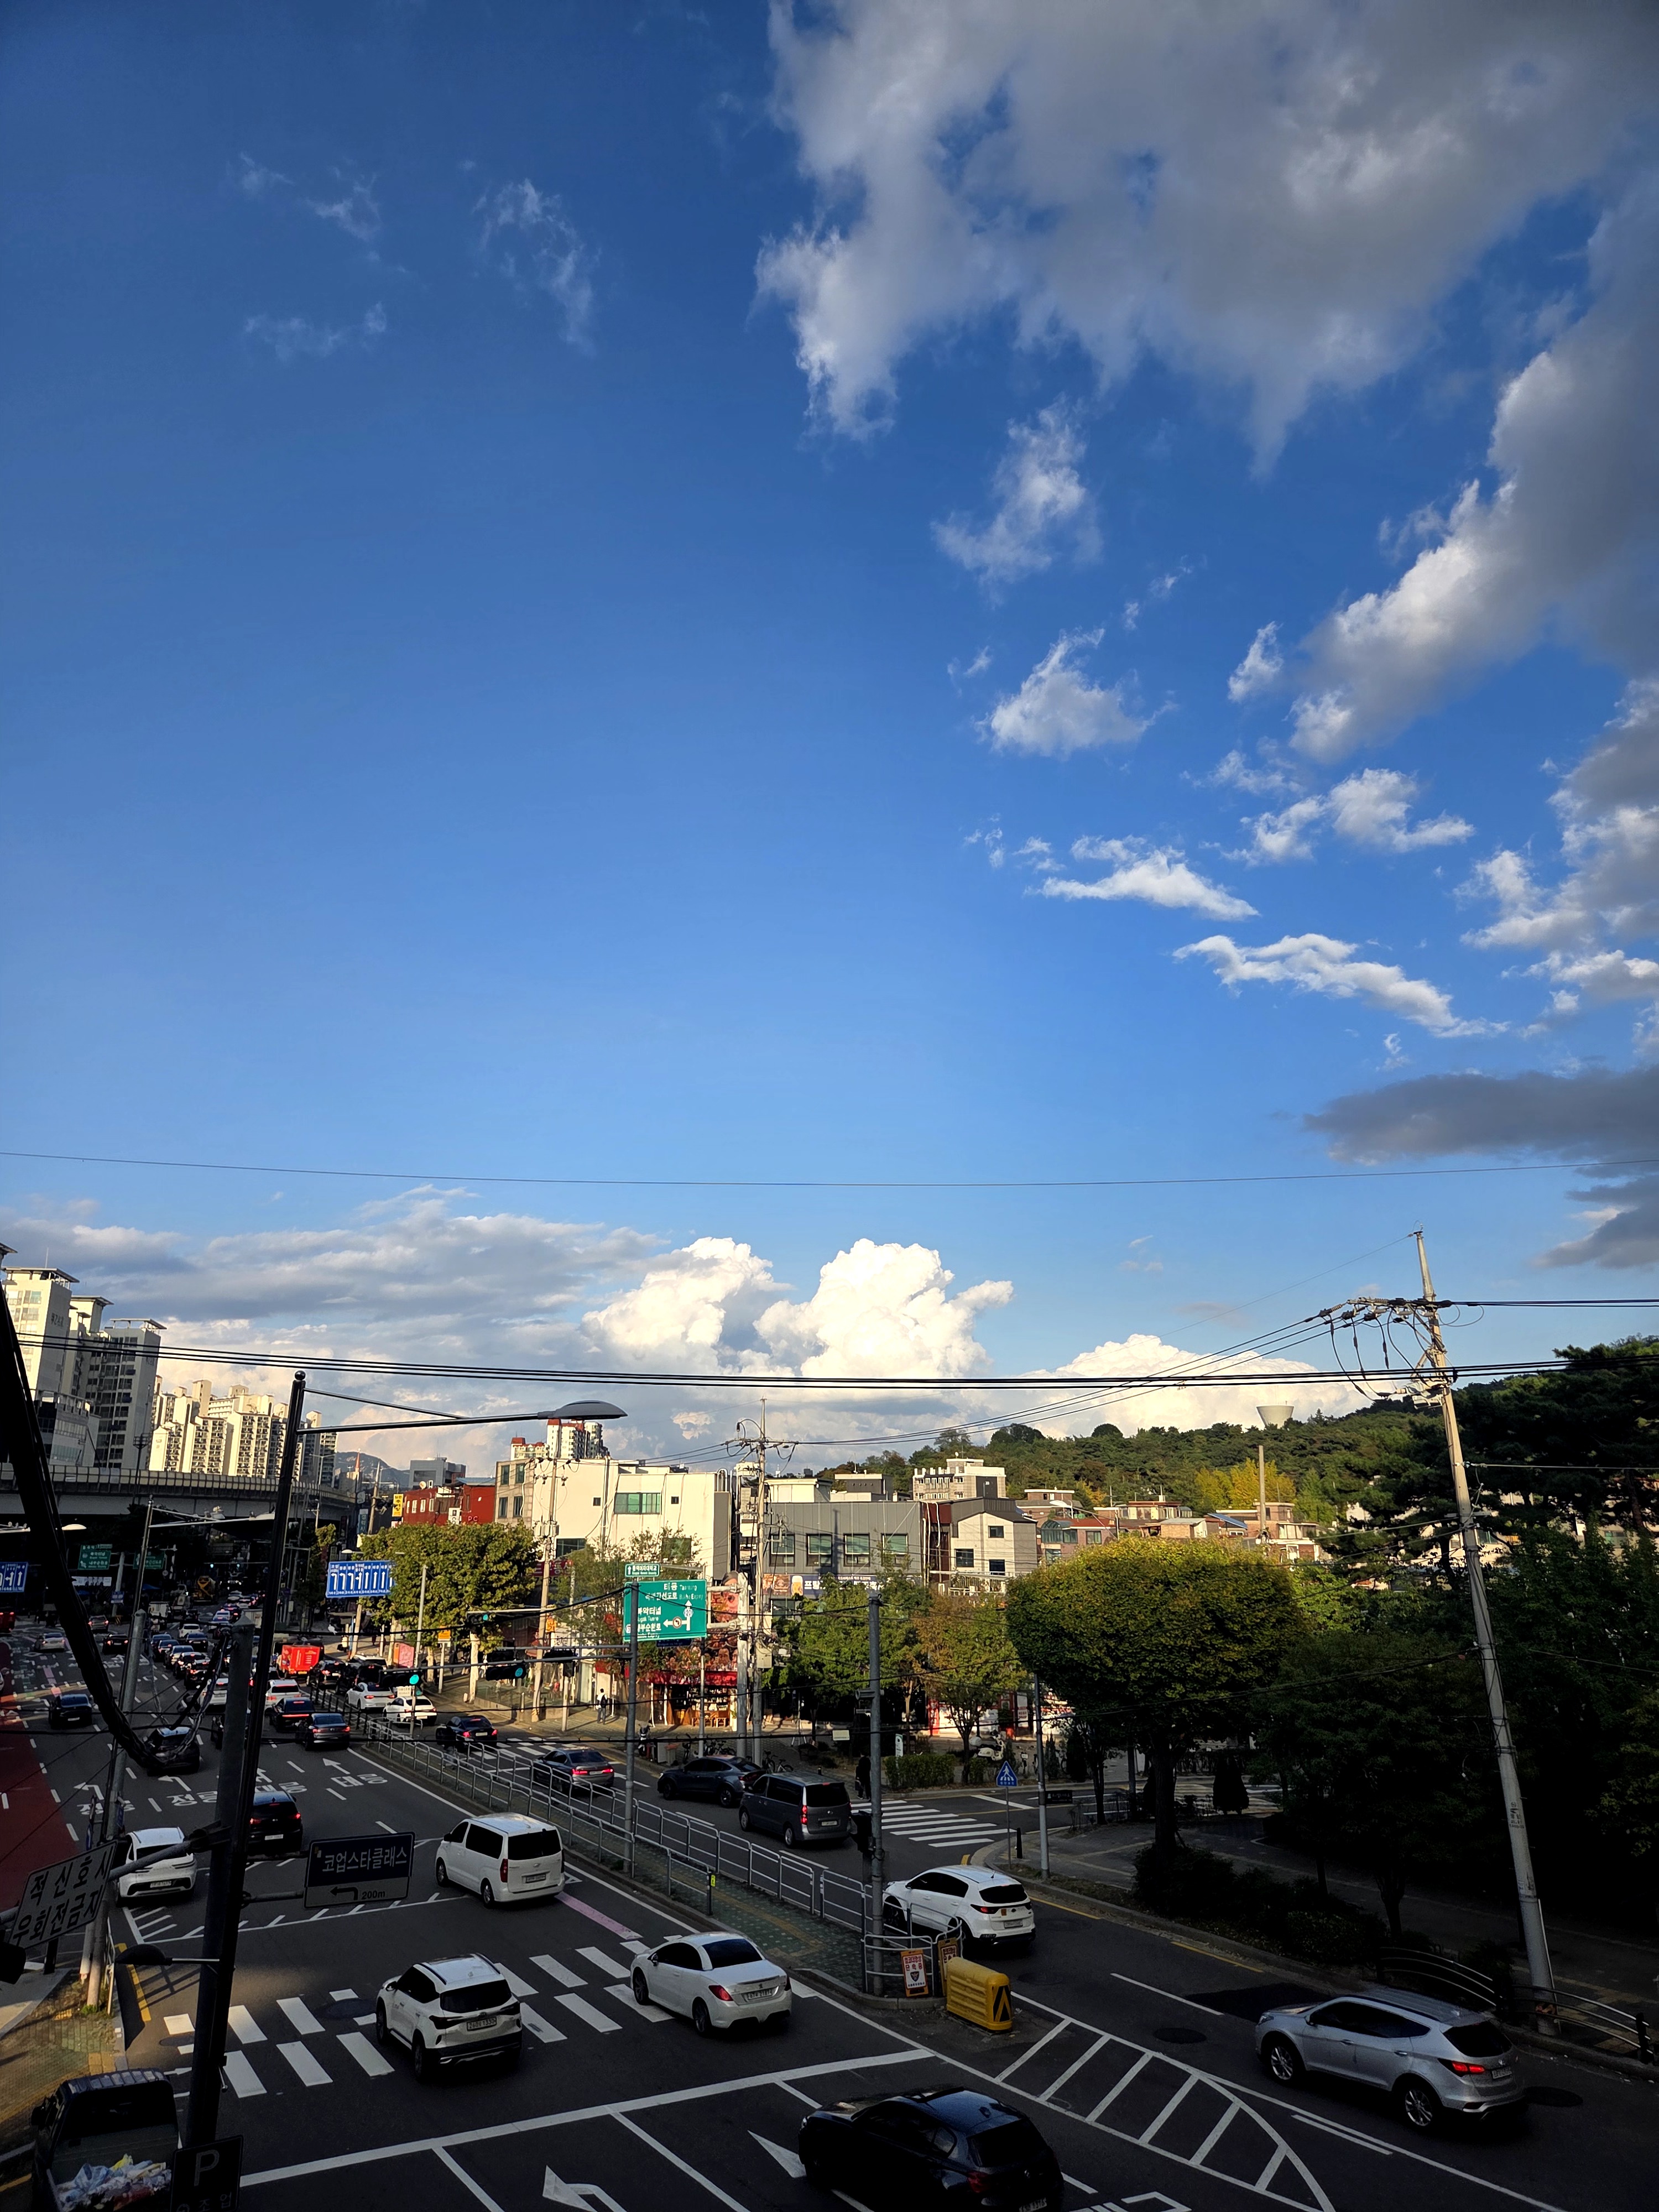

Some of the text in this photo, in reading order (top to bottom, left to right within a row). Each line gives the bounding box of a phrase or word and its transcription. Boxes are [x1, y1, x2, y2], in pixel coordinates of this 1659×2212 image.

[331, 1773, 388, 1788] 태릉
[322, 1845, 408, 1874] 코업스타클래스
[361, 1890, 385, 1900] 200m
[13, 1885, 103, 1947] 우회전금지
[194, 2149, 220, 2187] P
